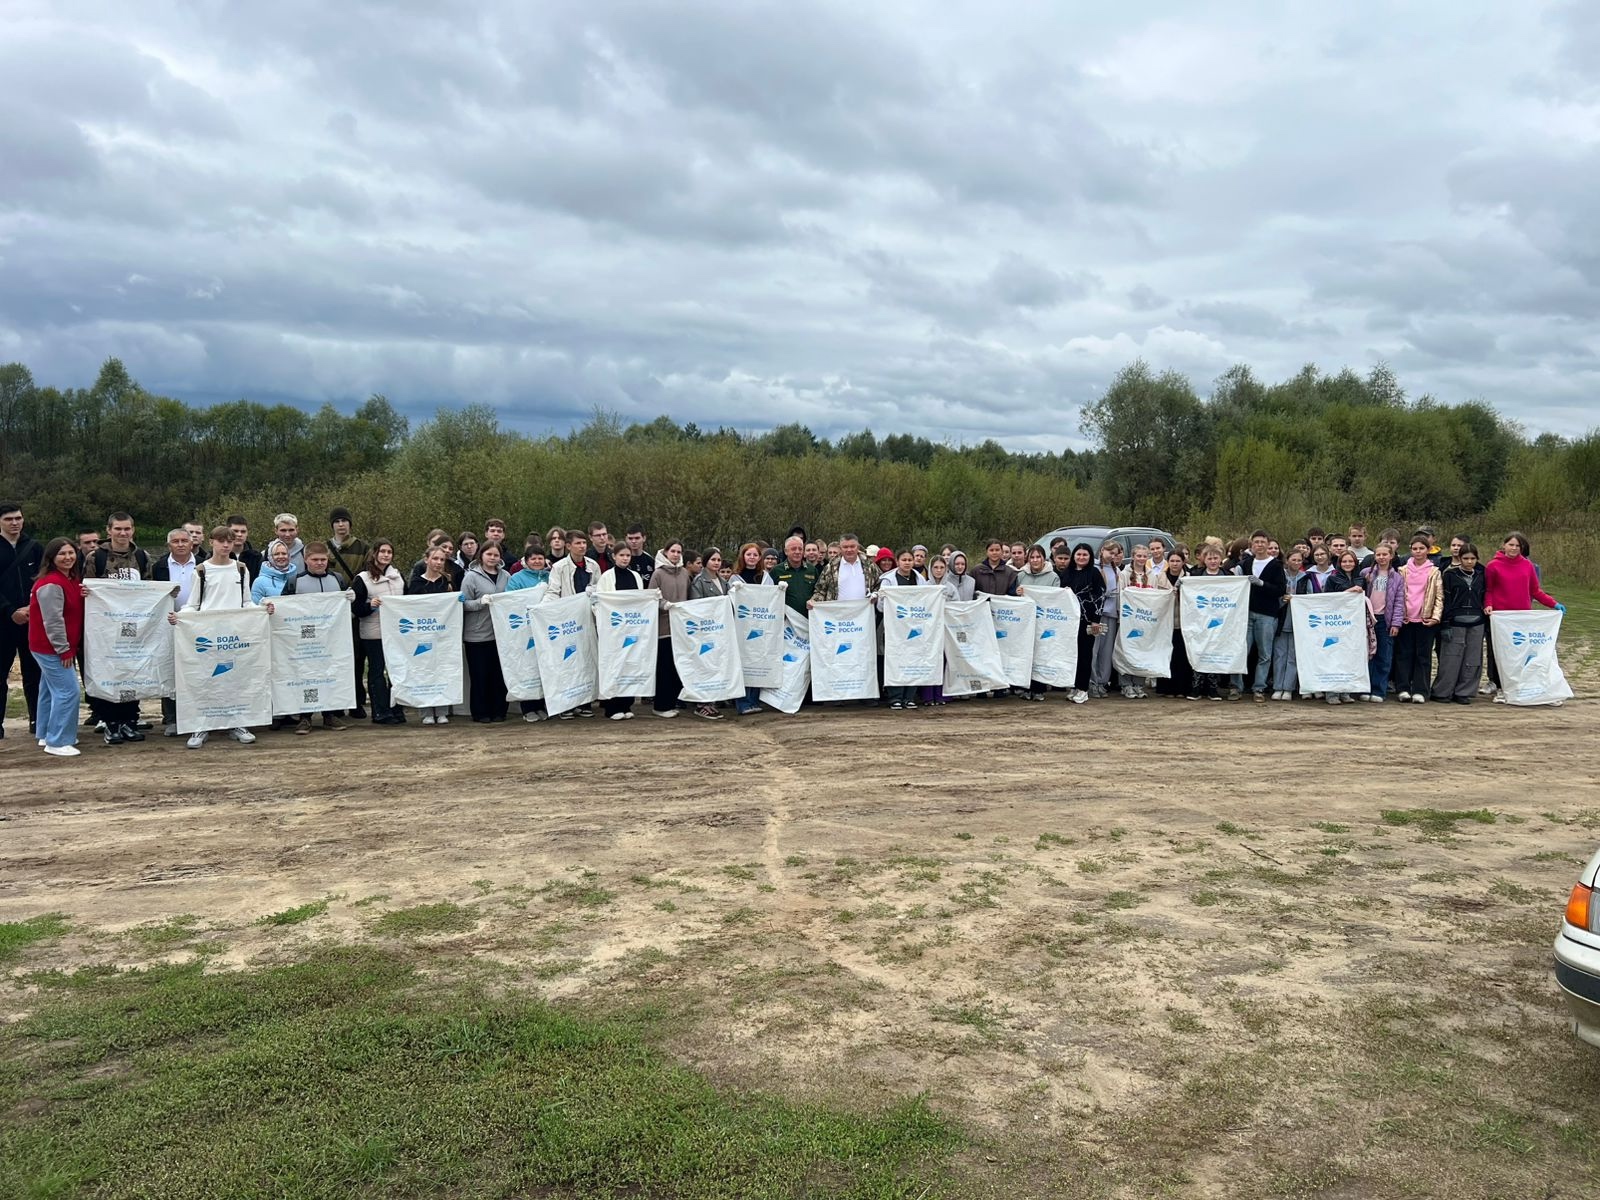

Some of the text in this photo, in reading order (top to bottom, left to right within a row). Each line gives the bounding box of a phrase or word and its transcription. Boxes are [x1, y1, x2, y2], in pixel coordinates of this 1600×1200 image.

[561, 620, 576, 629] ВОДА
[562, 625, 584, 636] РОССИИ
[217, 642, 250, 650] РОССИИ
[793, 640, 810, 650] РОССИ
